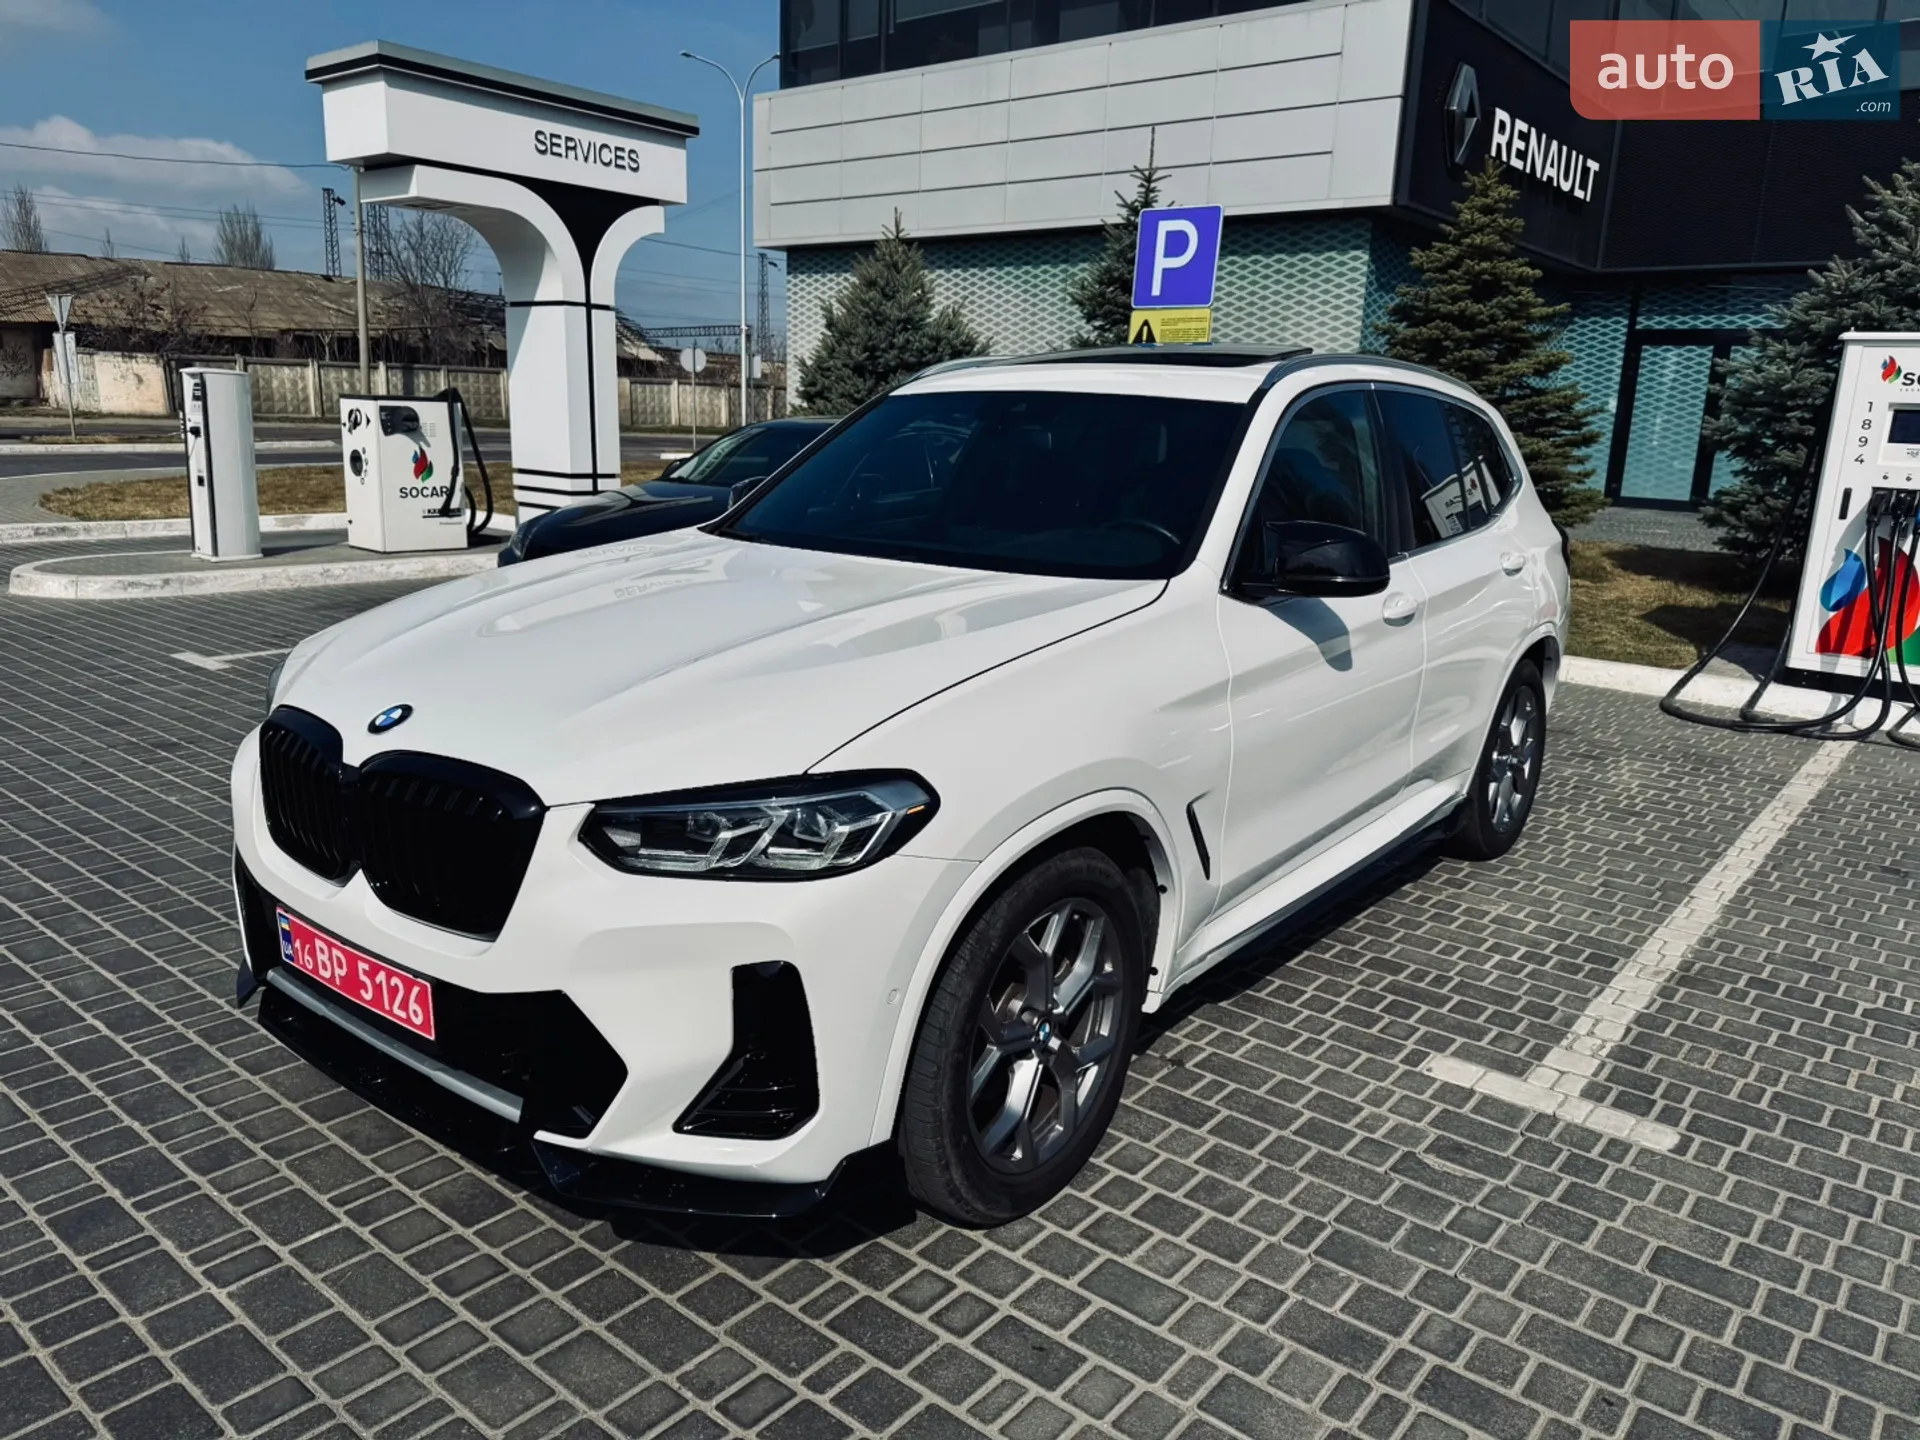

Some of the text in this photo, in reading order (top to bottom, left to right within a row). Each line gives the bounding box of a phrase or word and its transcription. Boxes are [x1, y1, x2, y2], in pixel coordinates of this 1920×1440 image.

[534, 129, 640, 173] SERVICES
[1490, 107, 1600, 202] RENAULT
[1151, 219, 1198, 296] P
[399, 486, 449, 499] SOCAR
[357, 960, 424, 1025] 5126
